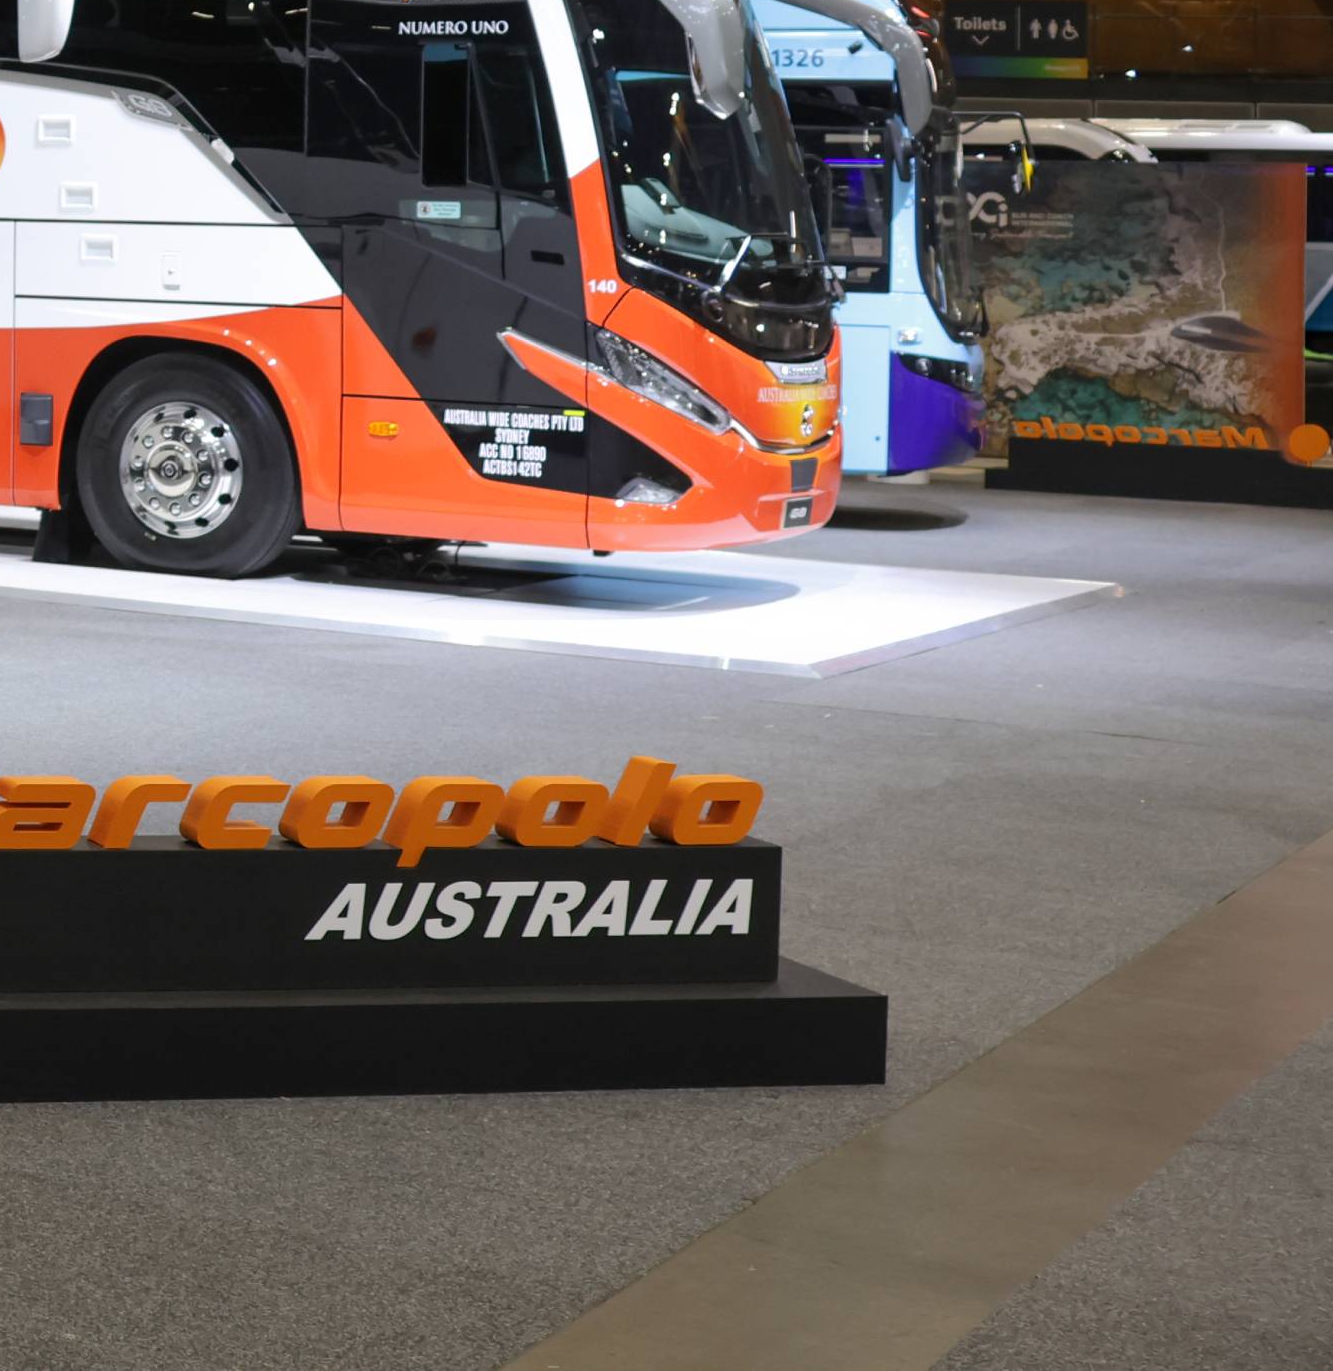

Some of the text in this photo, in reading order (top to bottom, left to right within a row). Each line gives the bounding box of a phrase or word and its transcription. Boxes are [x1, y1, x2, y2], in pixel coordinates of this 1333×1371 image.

[398, 20, 509, 35] NUMERO UNO
[953, 16, 1007, 32] Toilets
[771, 48, 825, 68] 1326
[587, 278, 617, 294] 140
[443, 408, 585, 432] AUSTRALIA WIDE COACHES PTY LTD
[494, 428, 531, 445] SYDNEY
[478, 443, 499, 459] ACC
[499, 444, 514, 459] NO
[304, 878, 753, 941] AUSTRALIA
